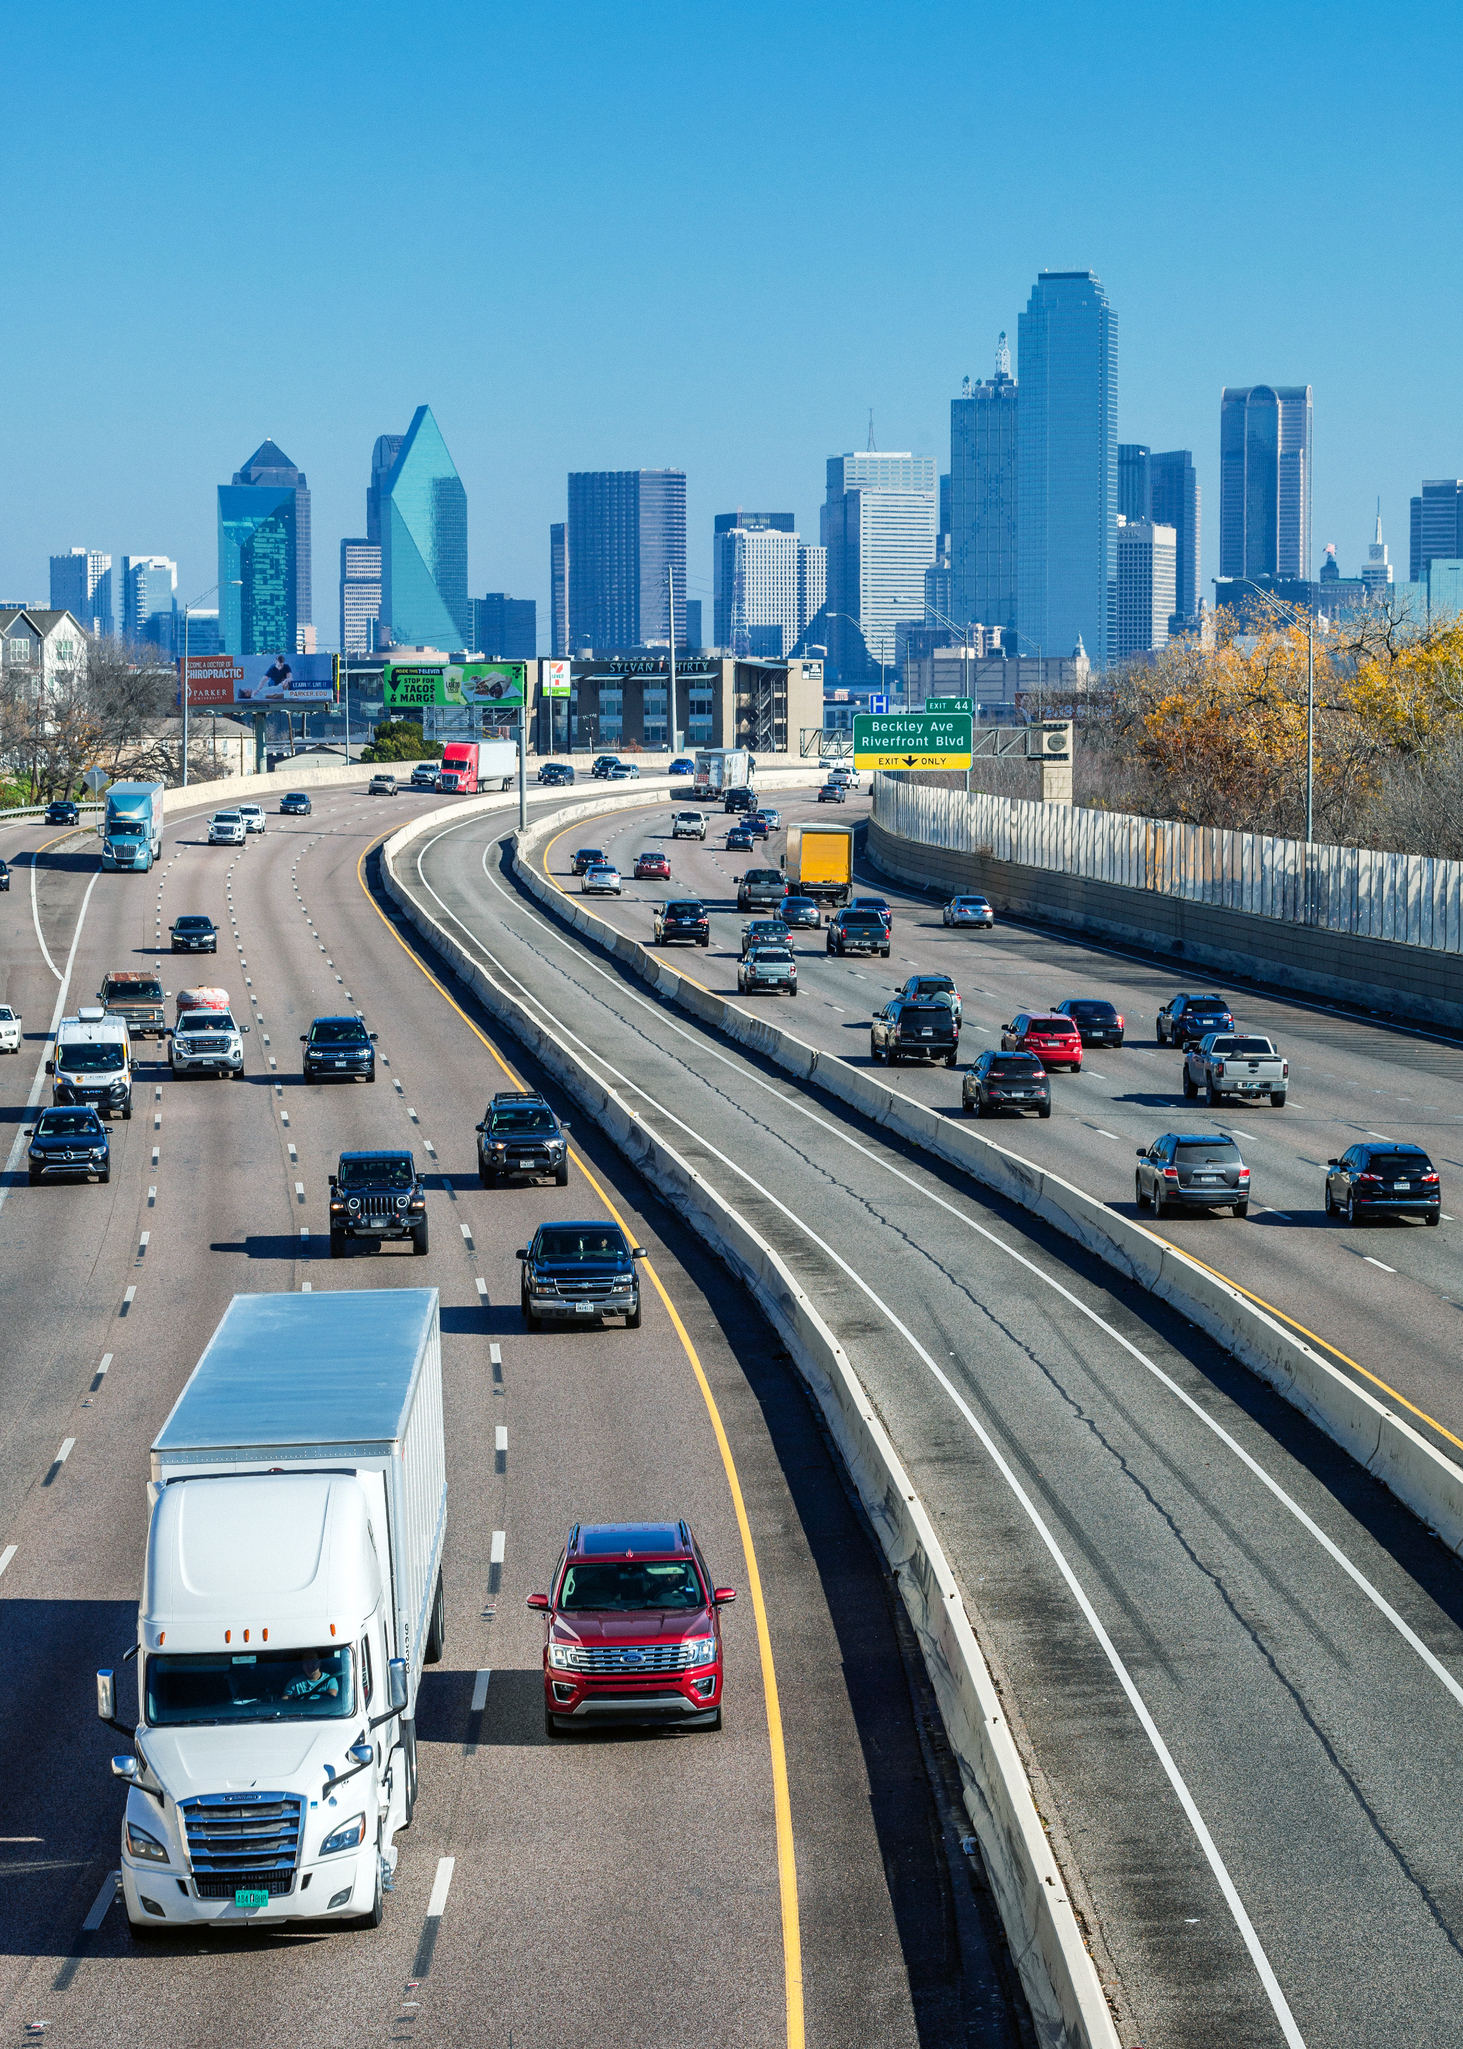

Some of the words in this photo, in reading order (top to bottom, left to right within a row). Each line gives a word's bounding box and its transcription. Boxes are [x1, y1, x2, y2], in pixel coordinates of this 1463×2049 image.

[609, 662, 653, 672] SYLVAN
[667, 662, 709, 671] THIRTY
[186, 669, 242, 679] CHIROPRACTIC
[404, 685, 435, 693] TACOS
[390, 694, 397, 702] &
[400, 694, 434, 702] MARGS
[873, 696, 887, 713] H
[955, 701, 969, 710] 44
[872, 721, 924, 734] Beckley
[930, 722, 954, 731] Ave
[862, 736, 929, 746] Riverfront
[936, 736, 964, 746] Blvd
